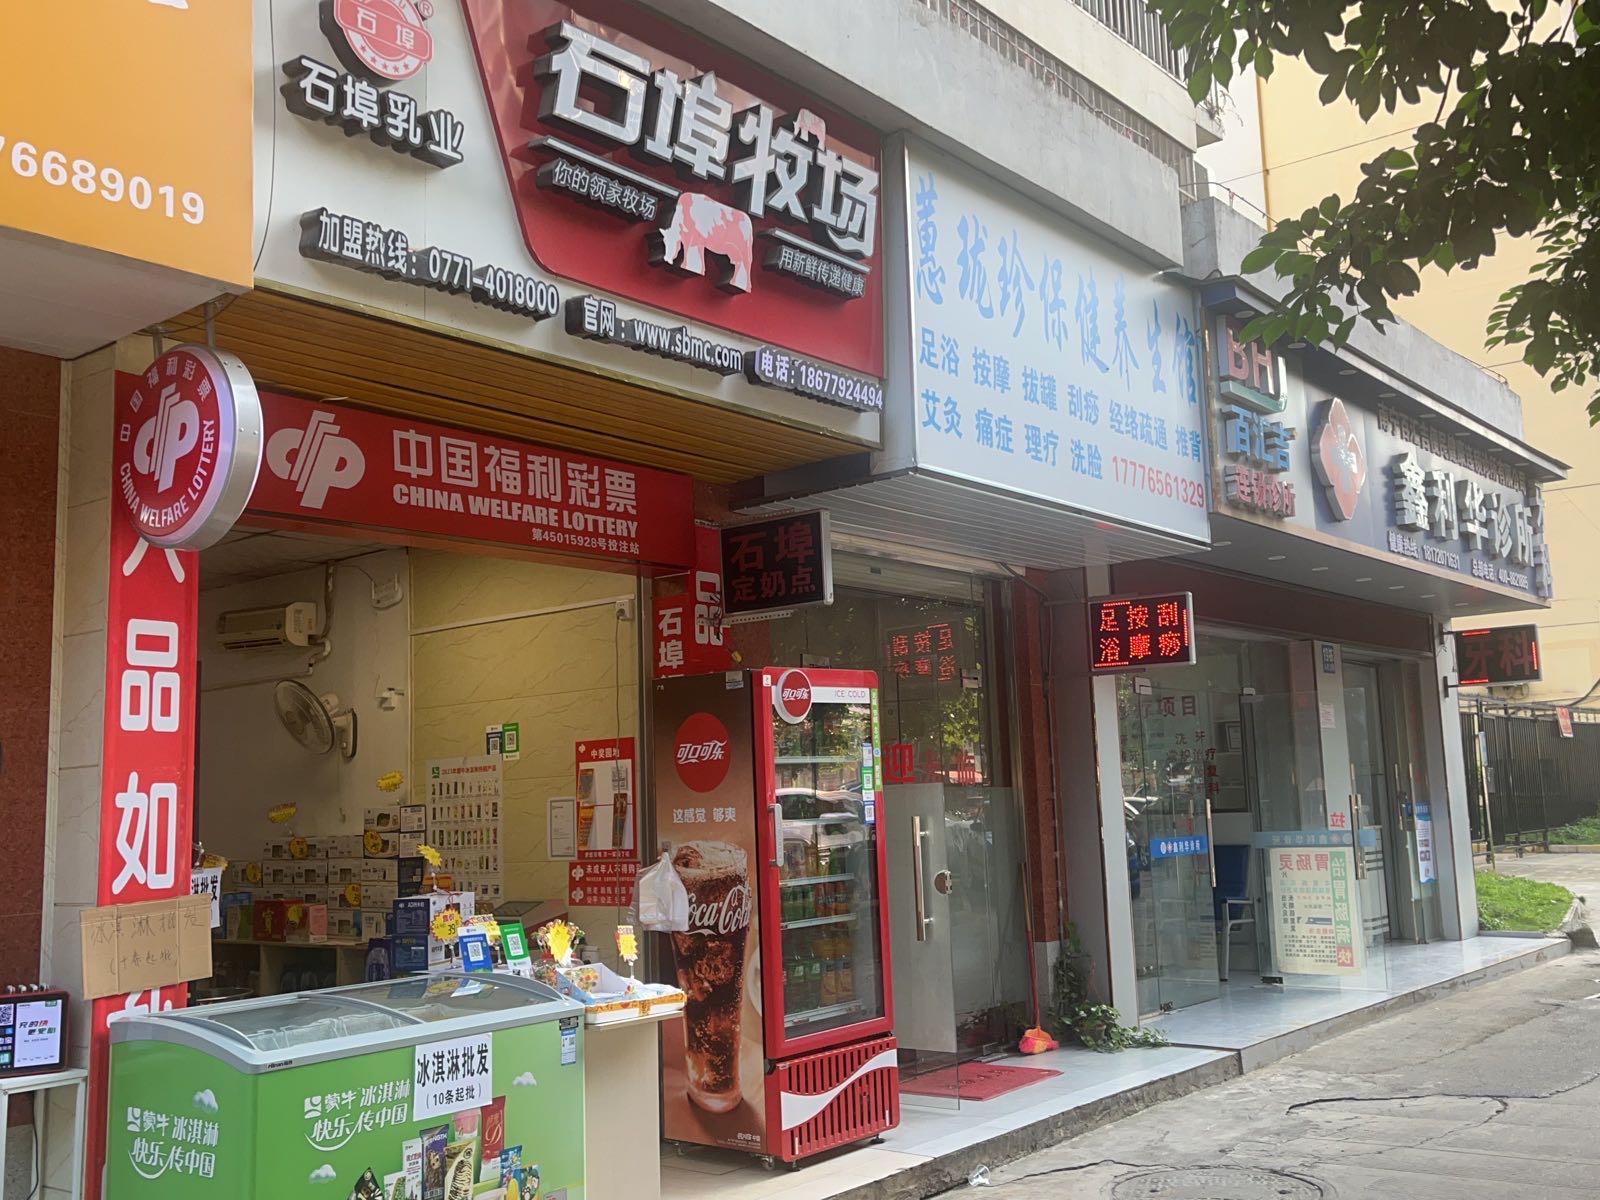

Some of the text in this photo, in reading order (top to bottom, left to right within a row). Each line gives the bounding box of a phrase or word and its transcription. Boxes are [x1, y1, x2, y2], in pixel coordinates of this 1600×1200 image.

[357, 6, 415, 50] 石埠
[299, 56, 464, 162] 石埠乳业
[551, 19, 881, 258] 石埠牧场
[0, 136, 206, 226] 6689019
[554, 160, 657, 219] 你的领家牧场
[919, 327, 960, 378] 足浴
[972, 346, 1012, 395] 按摩
[1021, 365, 1059, 412] 拔罐
[1109, 400, 1169, 453] 经络疏通
[1175, 424, 1201, 464] 推背
[392, 428, 638, 516] 中国福利彩票
[920, 388, 1206, 509] 艾灸 痛症 理疗 洗脸 17776561329
[119, 419, 216, 529] CHINA WELFARE LOTTERY
[392, 483, 639, 539] CHINA WELFARE LOTTERY
[1398, 450, 1536, 569] 鑫利华诊所
[531, 527, 640, 556] 第45015928号投注站
[728, 519, 817, 573] 石埠
[729, 566, 817, 603] 定奶点
[657, 606, 685, 679] 石埠
[1463, 630, 1534, 678] 牙科
[782, 687, 811, 701] 可口可乐
[834, 688, 867, 699] ICE COLD
[676, 739, 728, 766] 可口可乐
[672, 806, 737, 825] 这感觉 够爽
[416, 1043, 490, 1088] 冰淇淋批发
[324, 1078, 411, 1114] 蒙牛 冰淇淋
[142, 1110, 220, 1148] 蒙牛 冰淇淋
[310, 1103, 409, 1142] 快乐传中国
[130, 1136, 216, 1179] 快乐传中国
